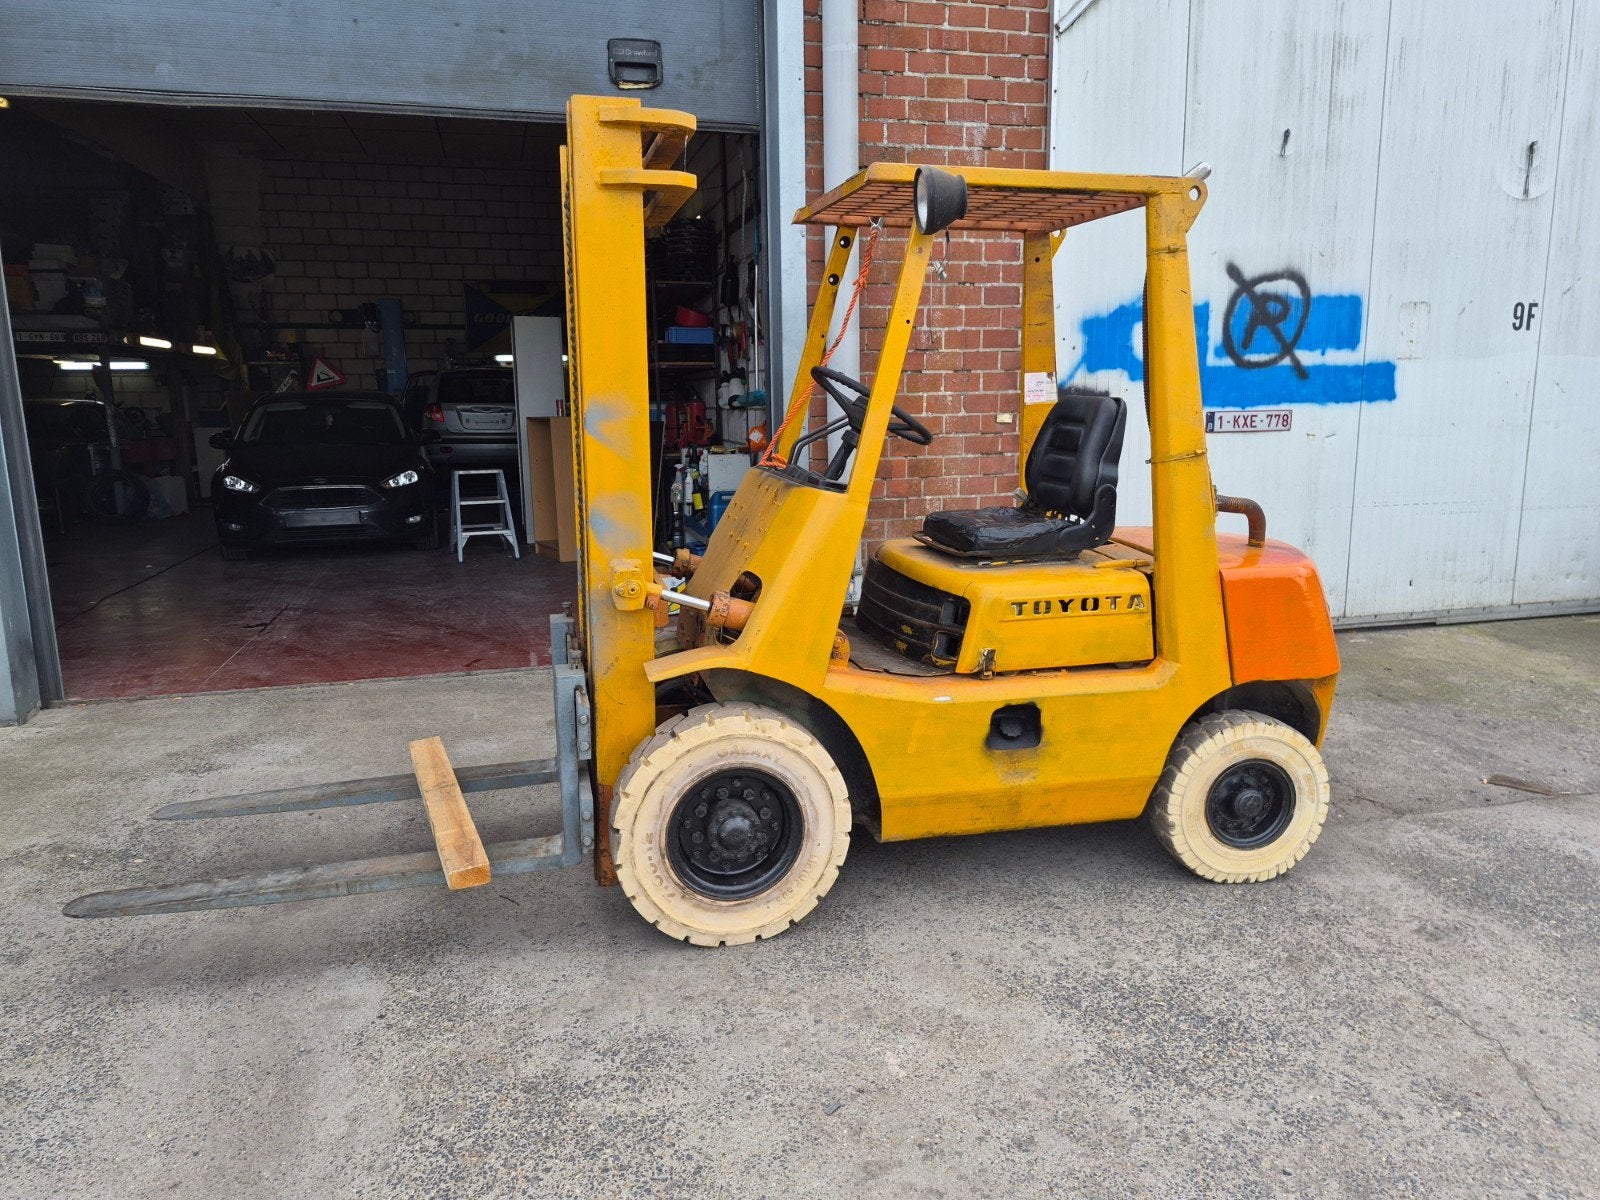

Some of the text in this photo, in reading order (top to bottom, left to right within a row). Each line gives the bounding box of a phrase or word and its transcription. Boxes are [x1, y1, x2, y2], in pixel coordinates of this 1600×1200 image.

[1512, 302, 1539, 331] 9F
[1217, 414, 1290, 429] 1-KXE-778
[1010, 594, 1146, 617] TOYOTA
